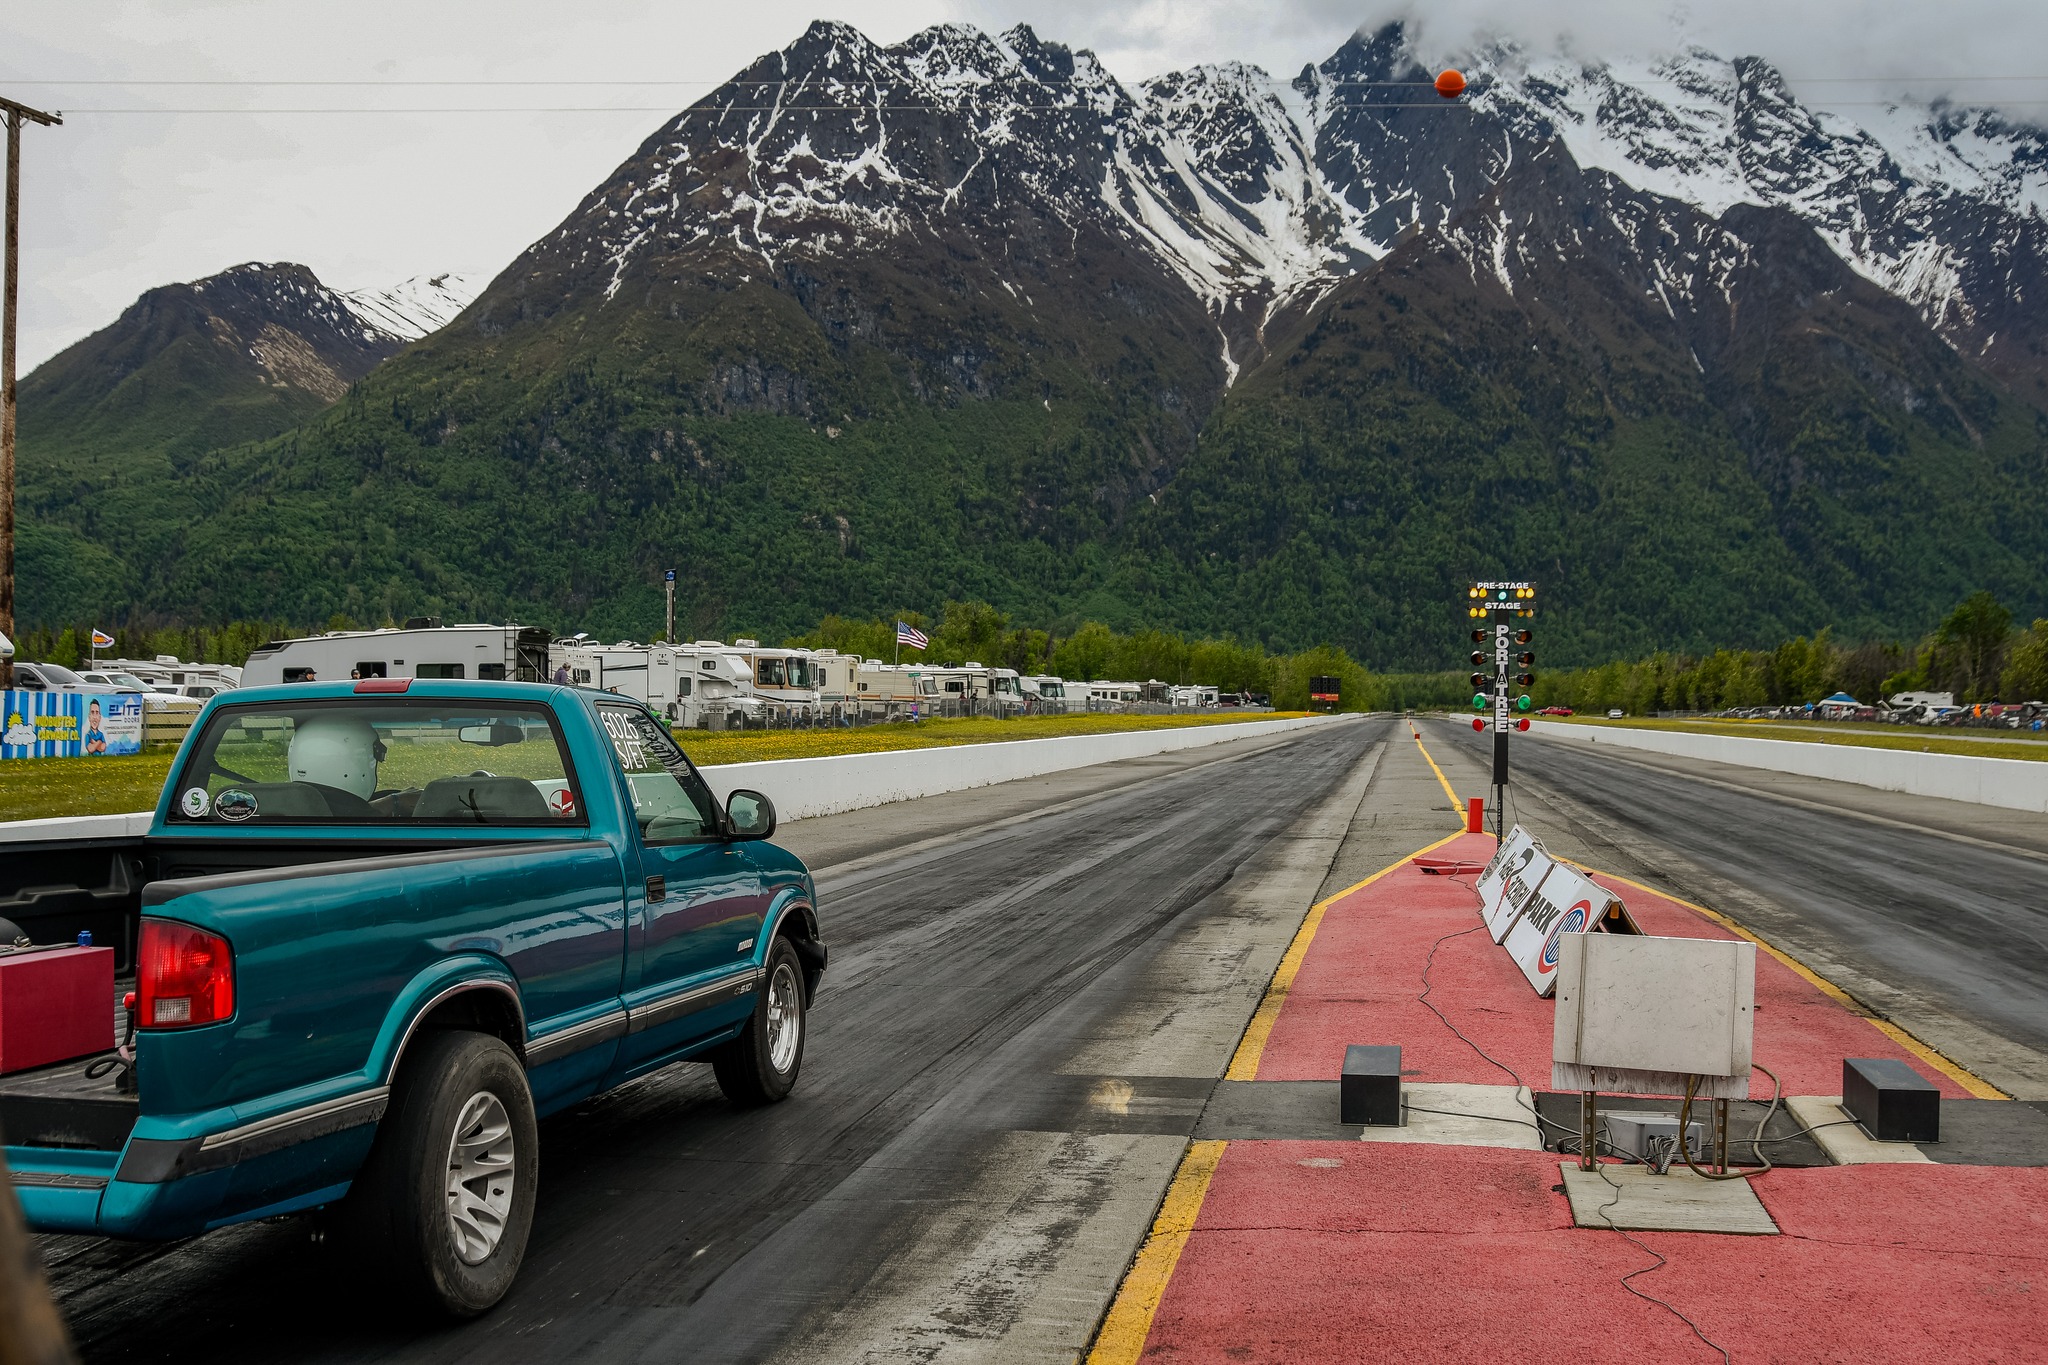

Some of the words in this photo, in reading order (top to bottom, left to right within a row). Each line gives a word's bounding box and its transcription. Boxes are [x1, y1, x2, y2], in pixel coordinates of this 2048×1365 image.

[1495, 625, 1509, 733] PORTATREE
[109, 704, 141, 716] ELITE
[600, 711, 639, 740] 6026
[1522, 893, 1561, 936] PARK
